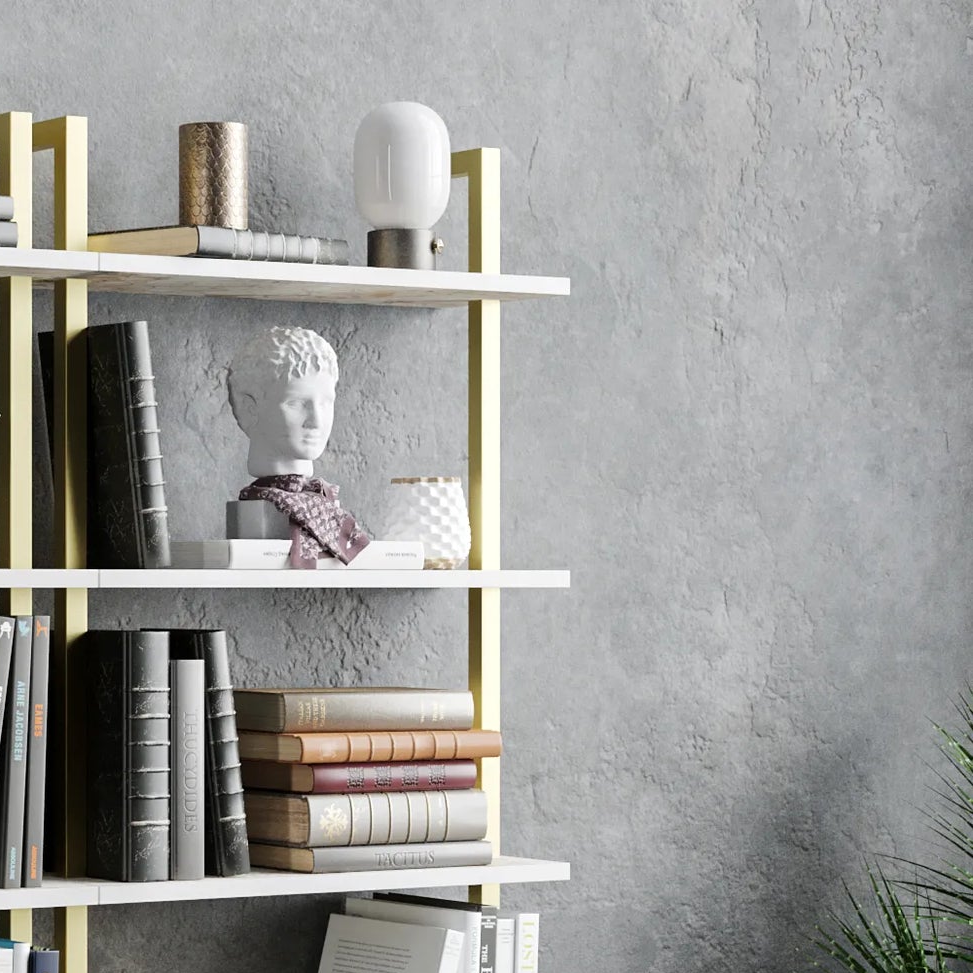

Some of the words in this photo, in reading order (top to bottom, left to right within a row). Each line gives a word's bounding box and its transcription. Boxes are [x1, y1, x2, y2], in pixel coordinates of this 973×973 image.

[15, 680, 25, 706] ARNE
[13, 708, 25, 762] JACOBSEN
[33, 703, 44, 737] EAMES
[183, 711, 199, 834] THUCYDIDES
[374, 850, 435, 867] TACITUS
[481, 944, 489, 963] THE
[520, 921, 535, 973] LOST
